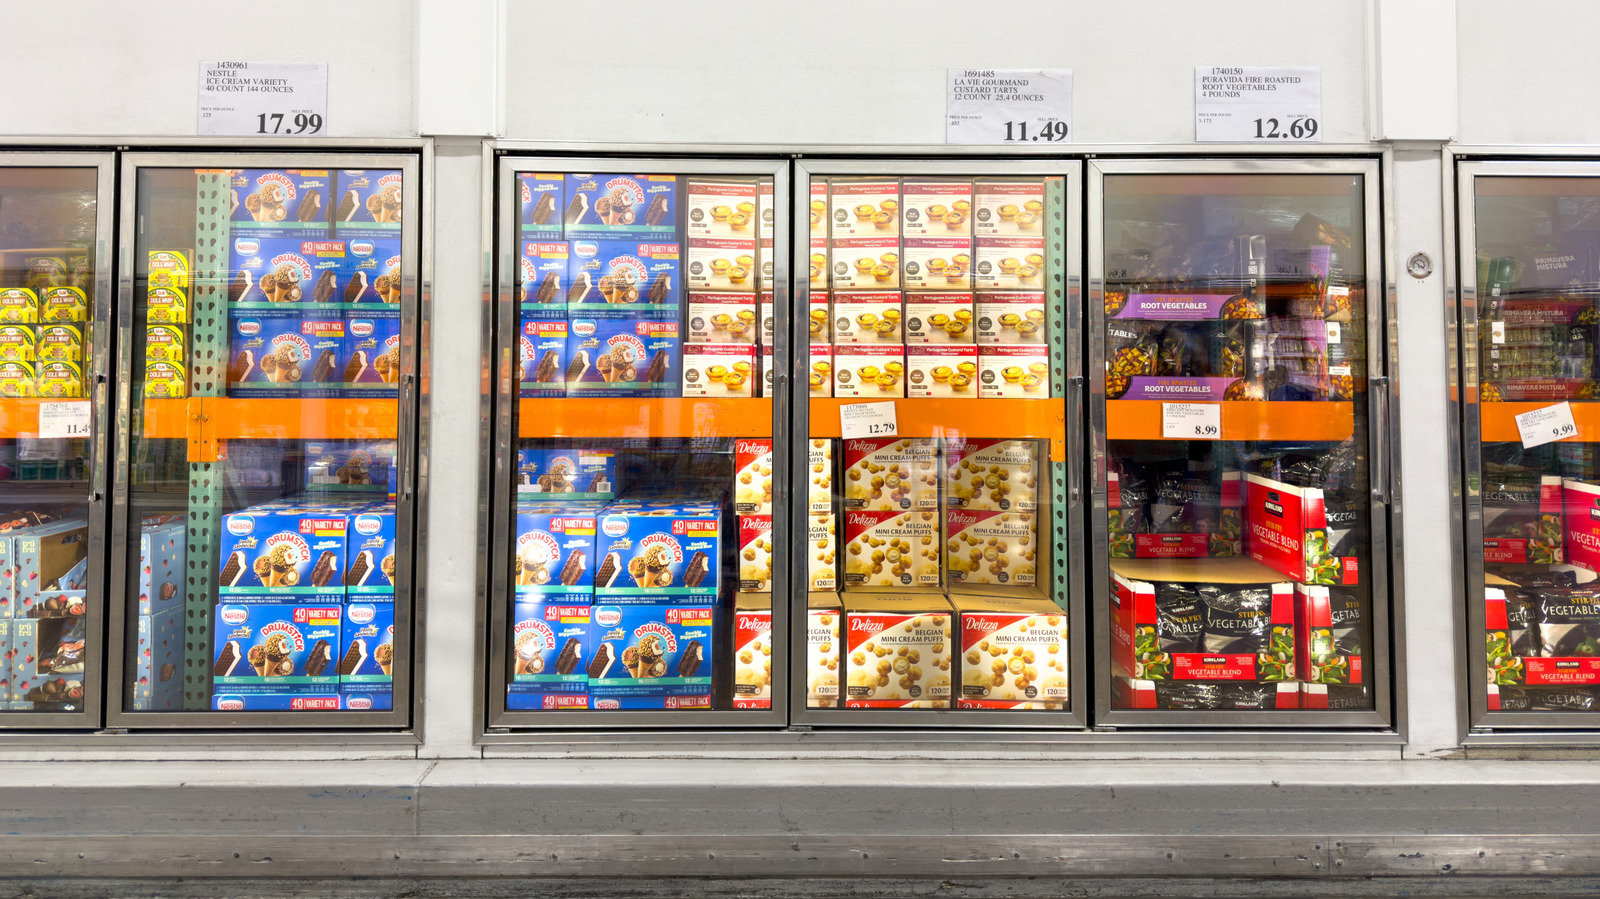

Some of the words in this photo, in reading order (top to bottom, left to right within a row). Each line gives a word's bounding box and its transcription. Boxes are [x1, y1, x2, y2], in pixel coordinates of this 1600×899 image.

[256, 113, 322, 134] 17.99
[1253, 118, 1318, 138] 12.69
[1004, 121, 1068, 141] 11.49
[256, 173, 296, 200] DRUMSTICK
[606, 178, 645, 204] DRUMSTICK
[1535, 255, 1576, 264] PRIMAVERA
[1536, 262, 1568, 271] MISTURA
[1110, 330, 1138, 338] TABLES
[272, 334, 311, 360] DRUMSTICK
[608, 335, 646, 360] DRUMSTICK
[869, 423, 895, 433] 12.79
[1195, 425, 1217, 435] 8.99
[1552, 424, 1574, 437] 9.99
[739, 442, 768, 454] Delizza
[849, 440, 877, 451] Delizza
[1265, 501, 1283, 513] KIRKLAND
[849, 513, 878, 524] Delizza
[949, 512, 976, 523] Delizza
[674, 521, 684, 529] 40
[1252, 523, 1279, 543] VEGETABLE
[1281, 535, 1299, 551] BLEND
[266, 533, 310, 562] DRUMSTICK
[641, 534, 683, 562] DRUMSTICK
[1542, 605, 1599, 615] VEGETABLE
[852, 618, 883, 632] Delizza
[966, 617, 998, 631] Delizza
[261, 622, 304, 651] DRUMSTICK
[635, 624, 677, 652] DRUMSTICK
